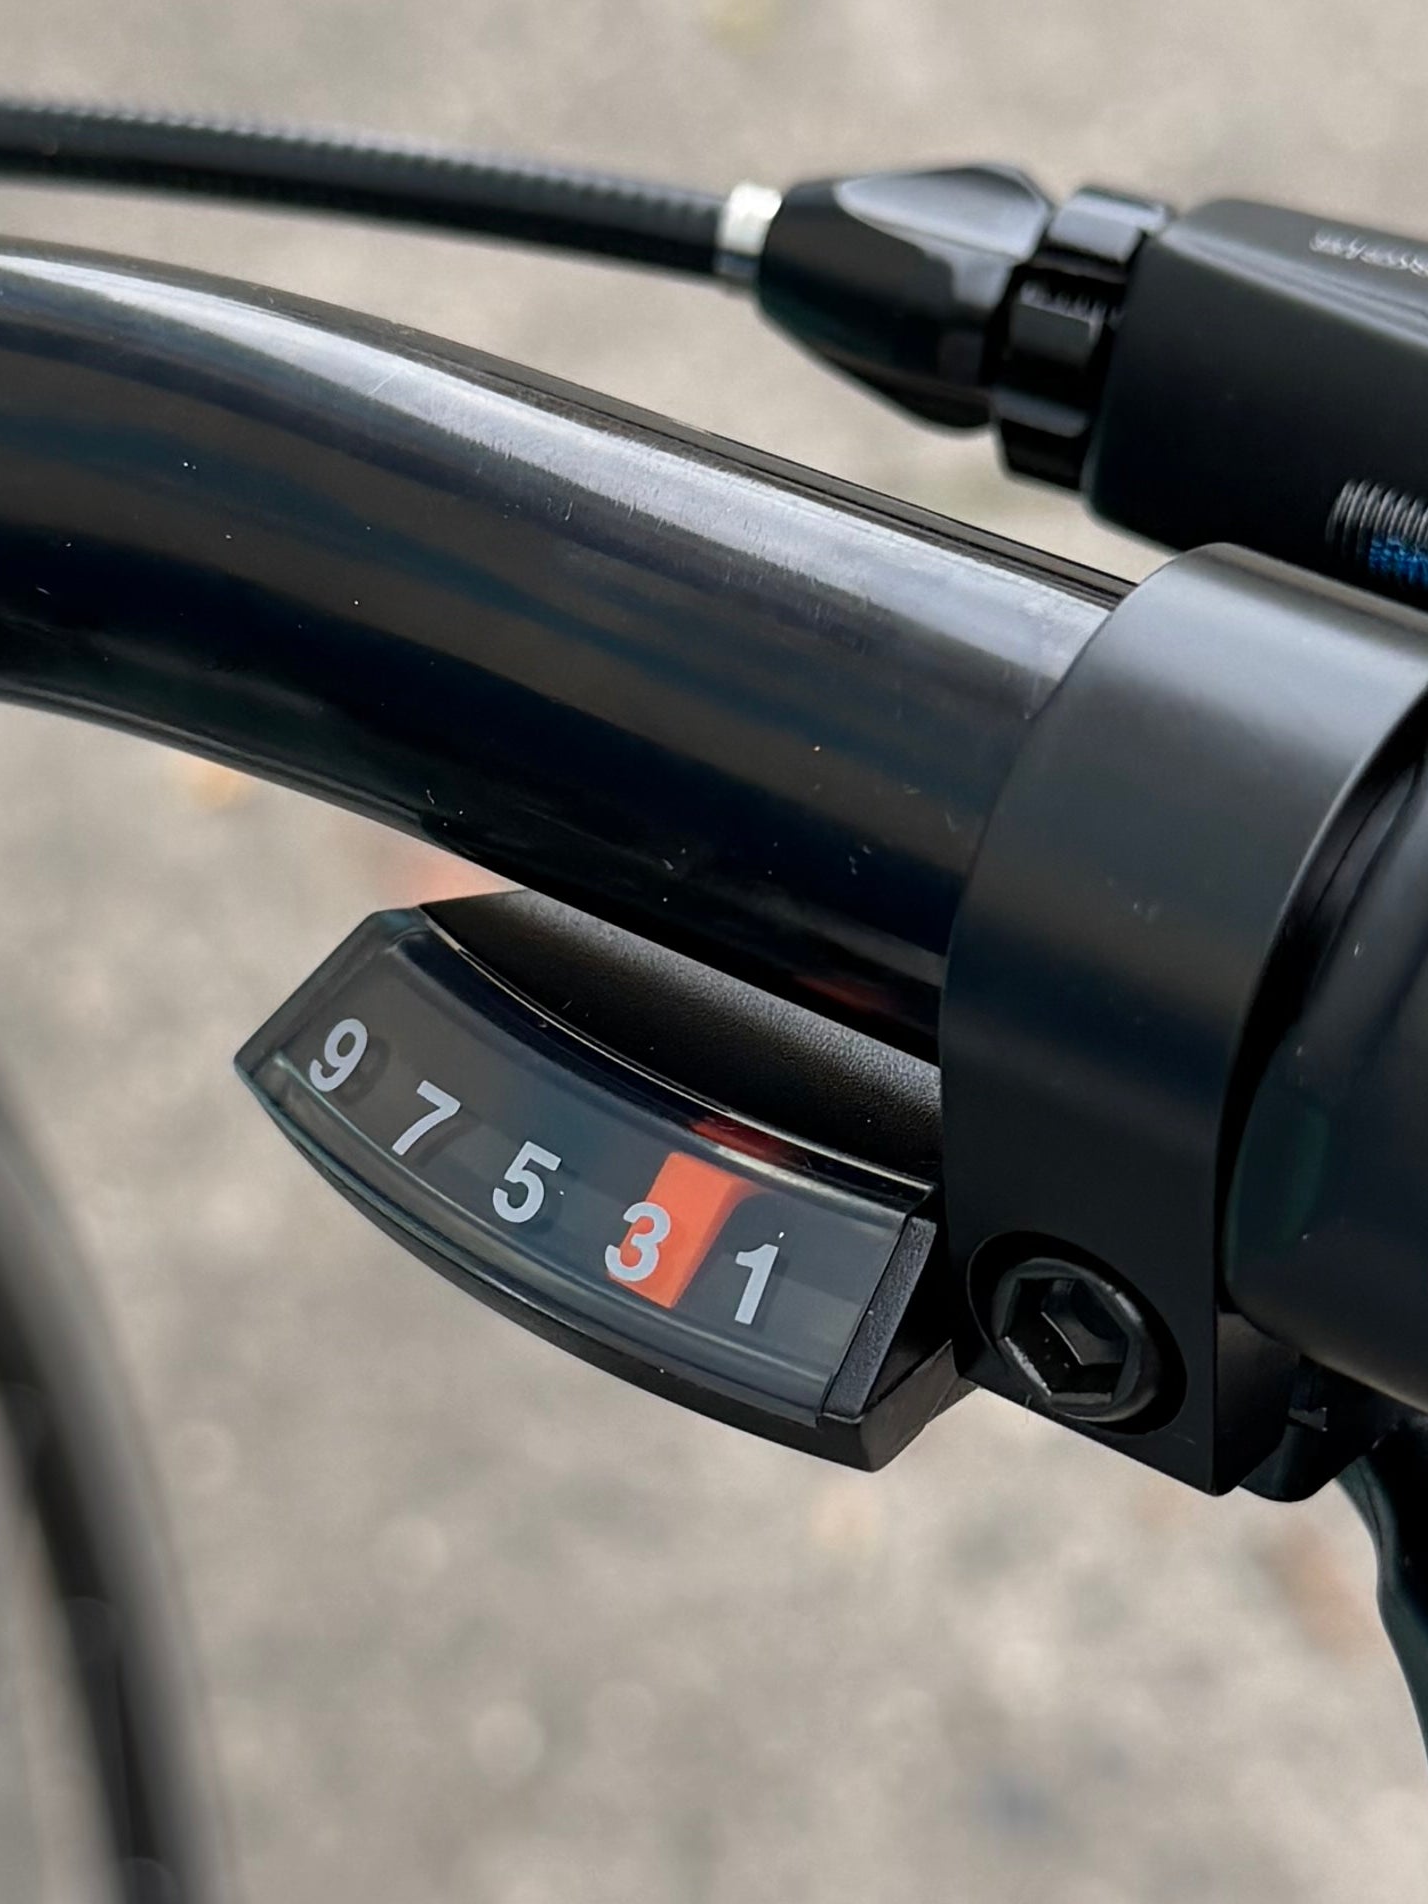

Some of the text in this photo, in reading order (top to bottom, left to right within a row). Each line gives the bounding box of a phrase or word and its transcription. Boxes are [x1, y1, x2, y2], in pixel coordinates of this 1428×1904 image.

[309, 1018, 779, 1325] 9 7 5 3 1
